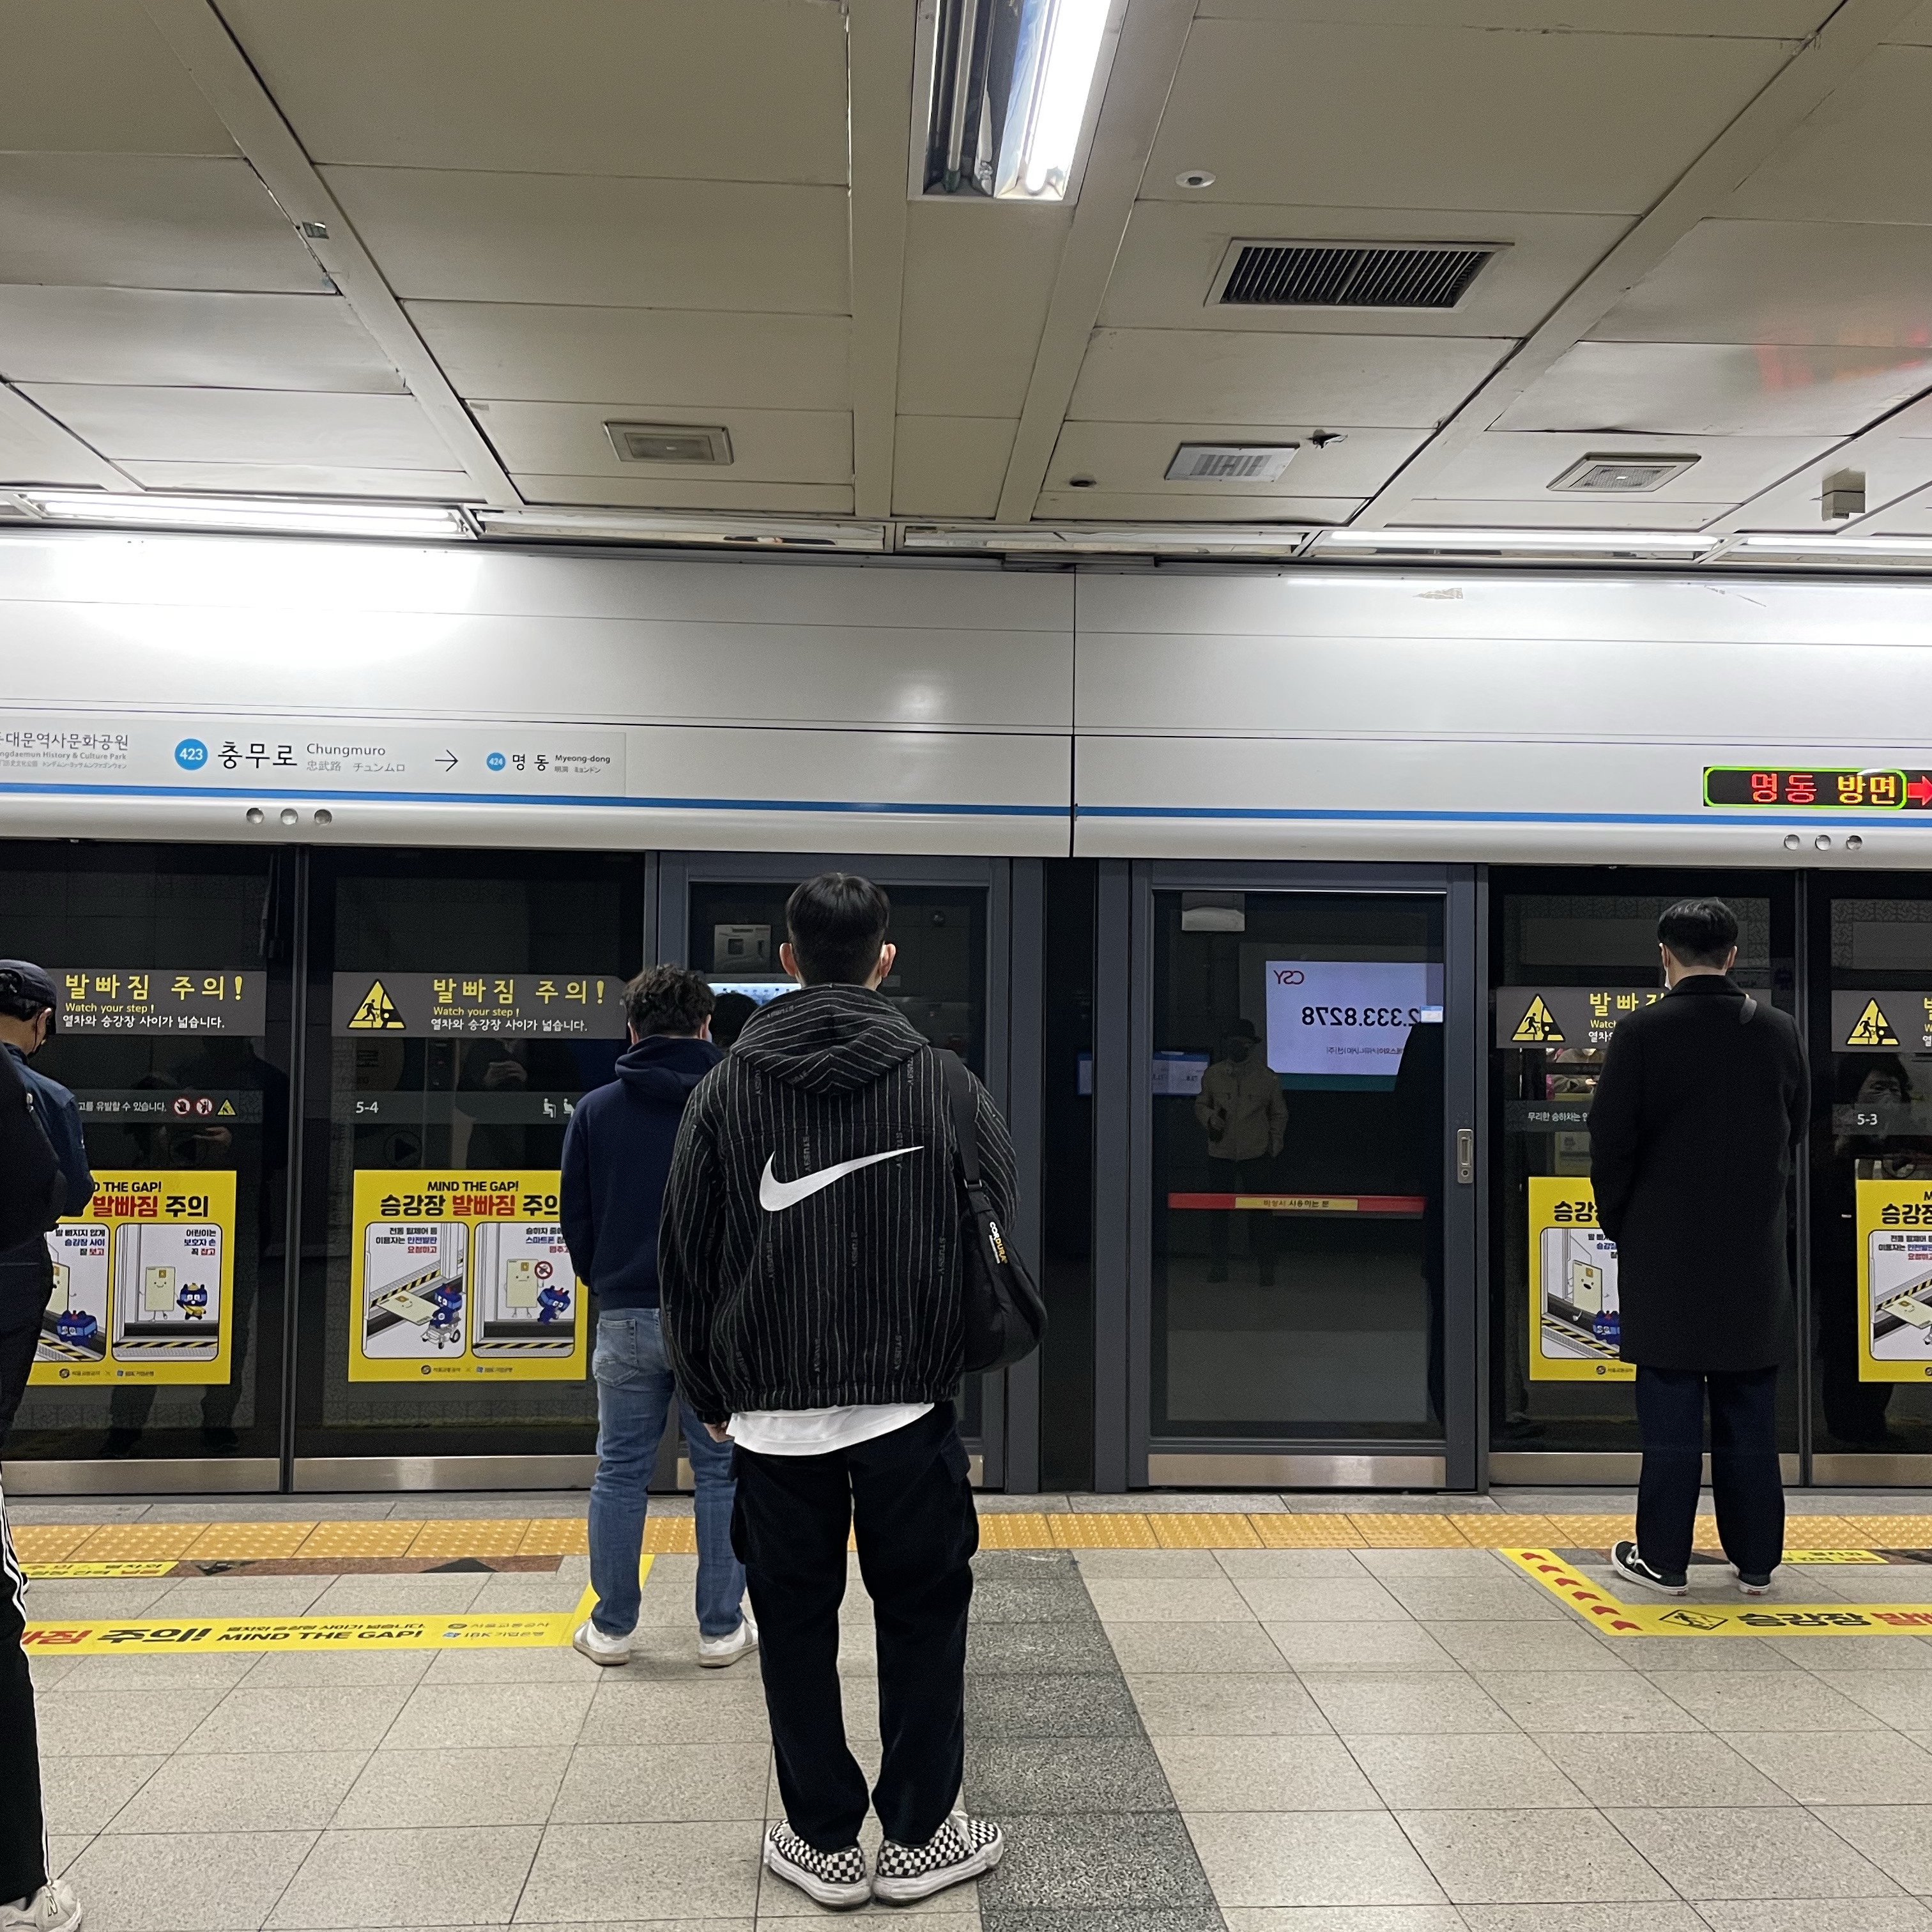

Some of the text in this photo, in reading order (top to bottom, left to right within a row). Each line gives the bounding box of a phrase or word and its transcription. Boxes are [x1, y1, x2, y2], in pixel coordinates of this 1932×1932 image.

[43, 751, 70, 760] History
[180, 748, 203, 760] 423
[218, 741, 298, 769] 충무로
[307, 743, 385, 758] Chungmuro
[489, 758, 503, 766] 424
[512, 754, 549, 771] 명동
[555, 755, 611, 764] Myeong-dong
[307, 760, 405, 772] 忠武路 チュンムロ
[1751, 772, 1895, 804] 명동 방면
[65, 974, 150, 1000] 발빠짐
[433, 978, 514, 1003] 발빠짐
[65, 1002, 96, 1012] Watch
[101, 1004, 123, 1014] your
[433, 1007, 464, 1016] Watch
[467, 1009, 489, 1017] your
[63, 1015, 225, 1029] 열차와 승강장 사이가 넓습니다.
[431, 1018, 588, 1032] 열차와 승강장 사이가 넓습니다.
[122, 1102, 131, 1111] 수
[355, 1101, 379, 1113] 5-4
[1857, 1114, 1878, 1125] 5-3
[103, 1182, 128, 1192] THE
[132, 1181, 161, 1192] GAP!
[427, 1181, 519, 1192] MIND THE GAP!
[93, 1195, 208, 1217] 발빠짐 주의
[380, 1194, 445, 1216] 승강장
[452, 1194, 516, 1216] 발빠짐
[1554, 1200, 1598, 1222] 승강
[1737, 1613, 1872, 1626] 승강장
[98, 1628, 212, 1644] 주의!
[216, 1633, 290, 1641] MIND
[358, 1630, 423, 1639] GAP!
